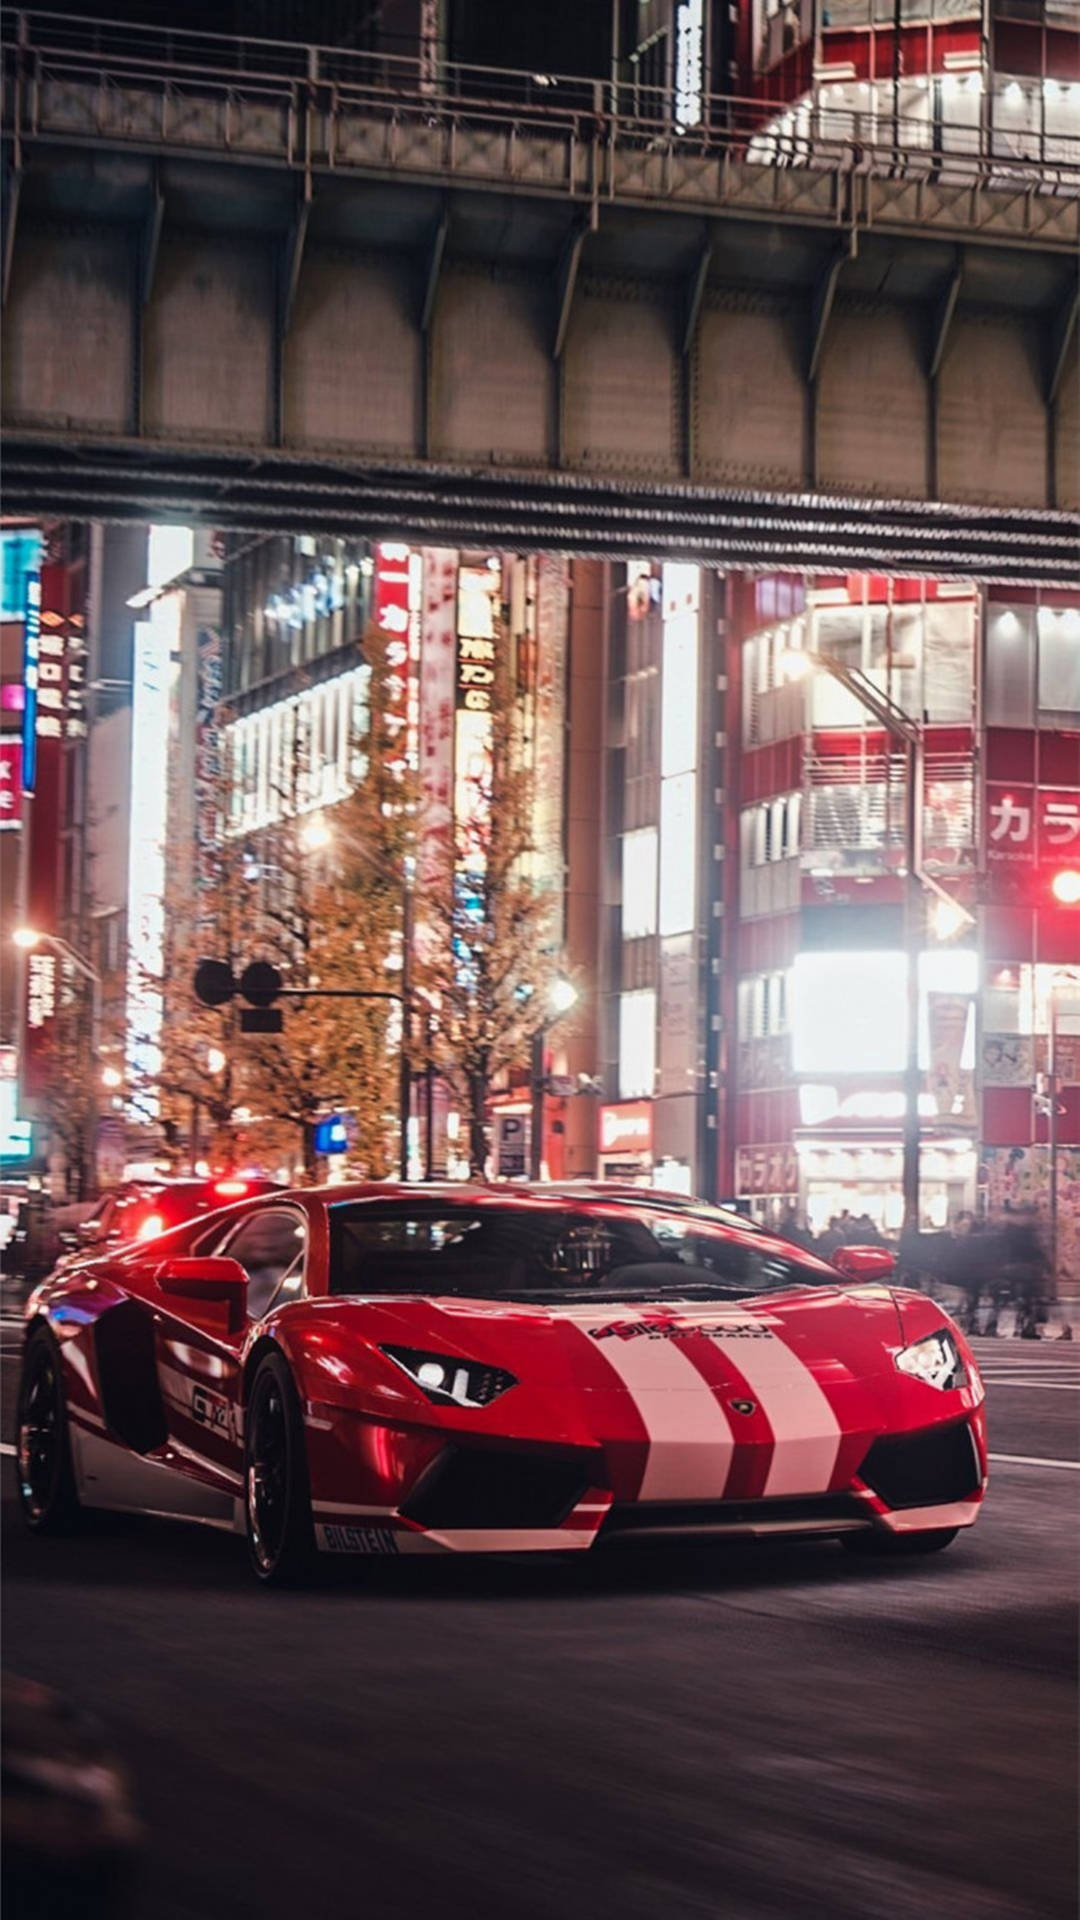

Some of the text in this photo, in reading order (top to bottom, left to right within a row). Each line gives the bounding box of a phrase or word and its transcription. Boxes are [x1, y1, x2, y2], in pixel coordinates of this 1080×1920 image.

[990, 796, 1080, 844] カラ
[502, 1118, 520, 1141] P
[325, 1526, 398, 1554] BILSTEIN
